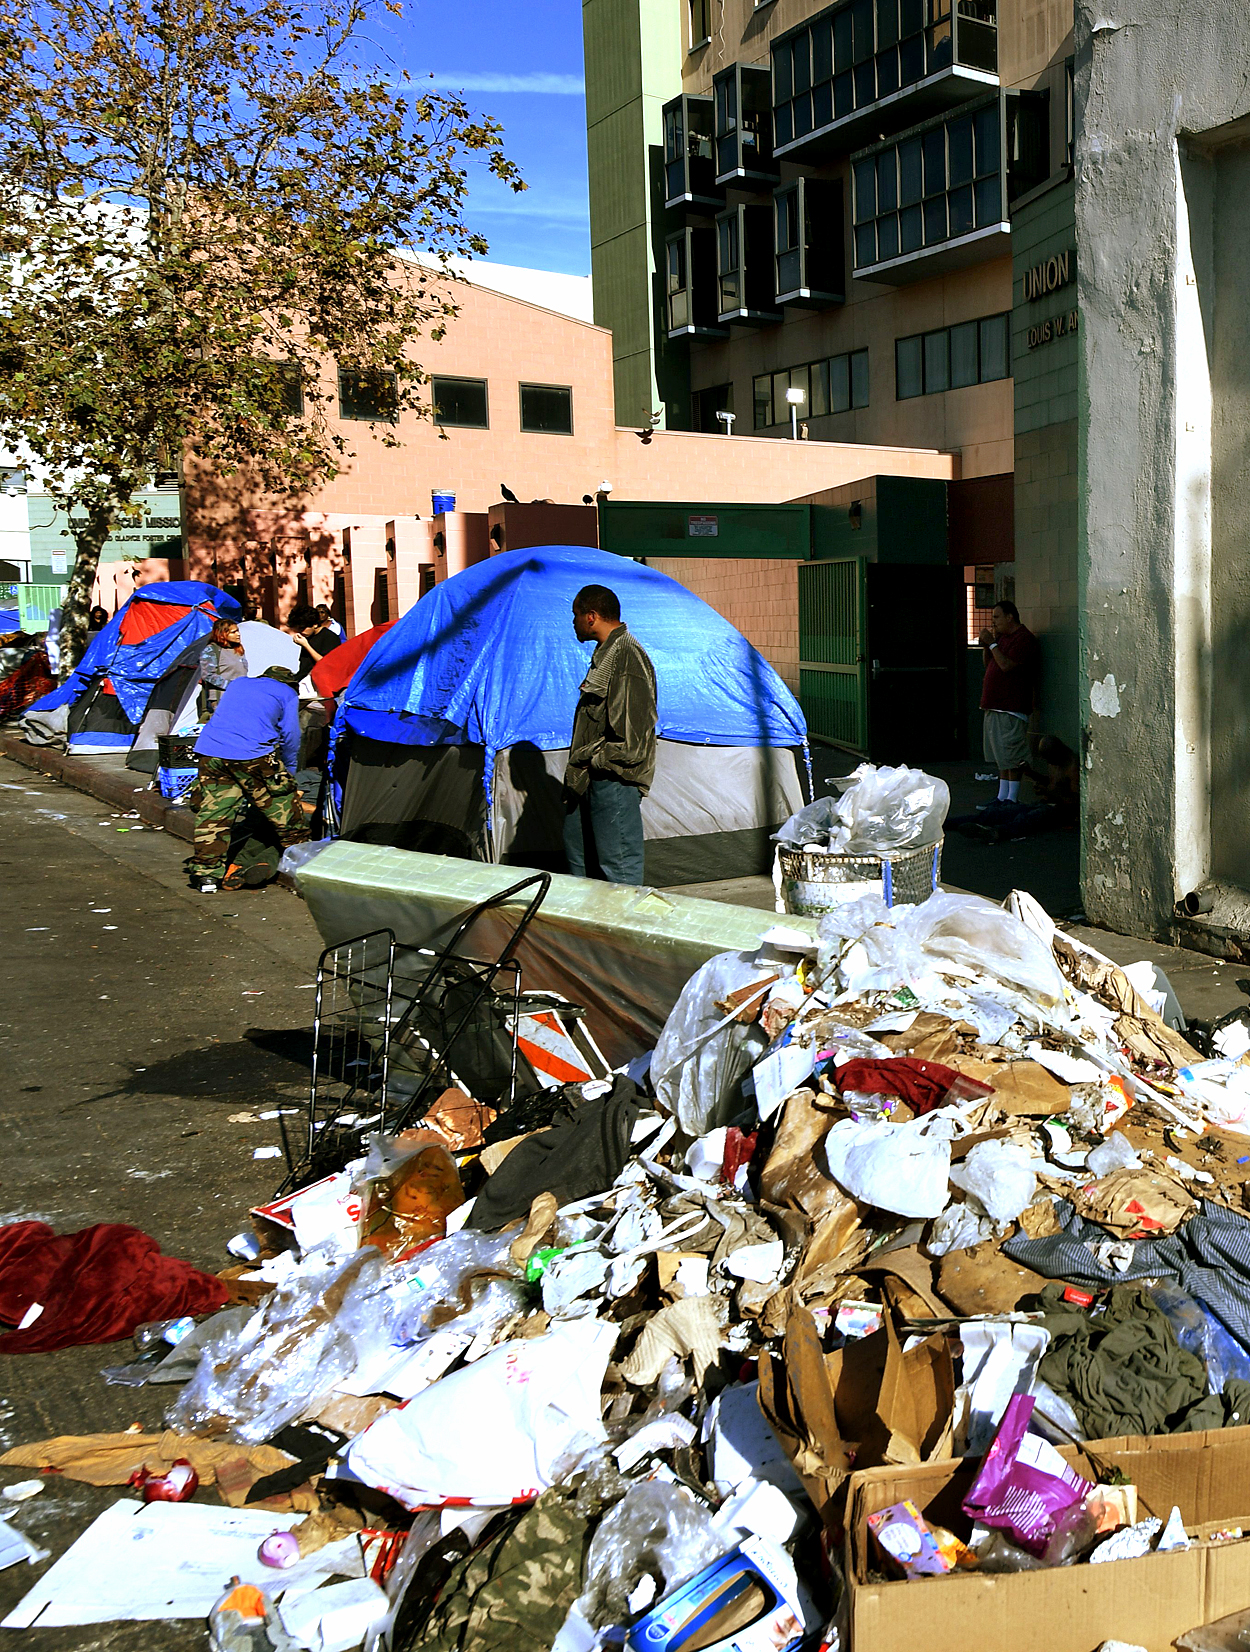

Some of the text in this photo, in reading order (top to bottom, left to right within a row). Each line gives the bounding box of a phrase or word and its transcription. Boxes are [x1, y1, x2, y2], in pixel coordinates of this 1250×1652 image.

[1022, 249, 1070, 302] UNION
[1026, 322, 1052, 348] LOUIS
[145, 517, 181, 529] MISSIO
